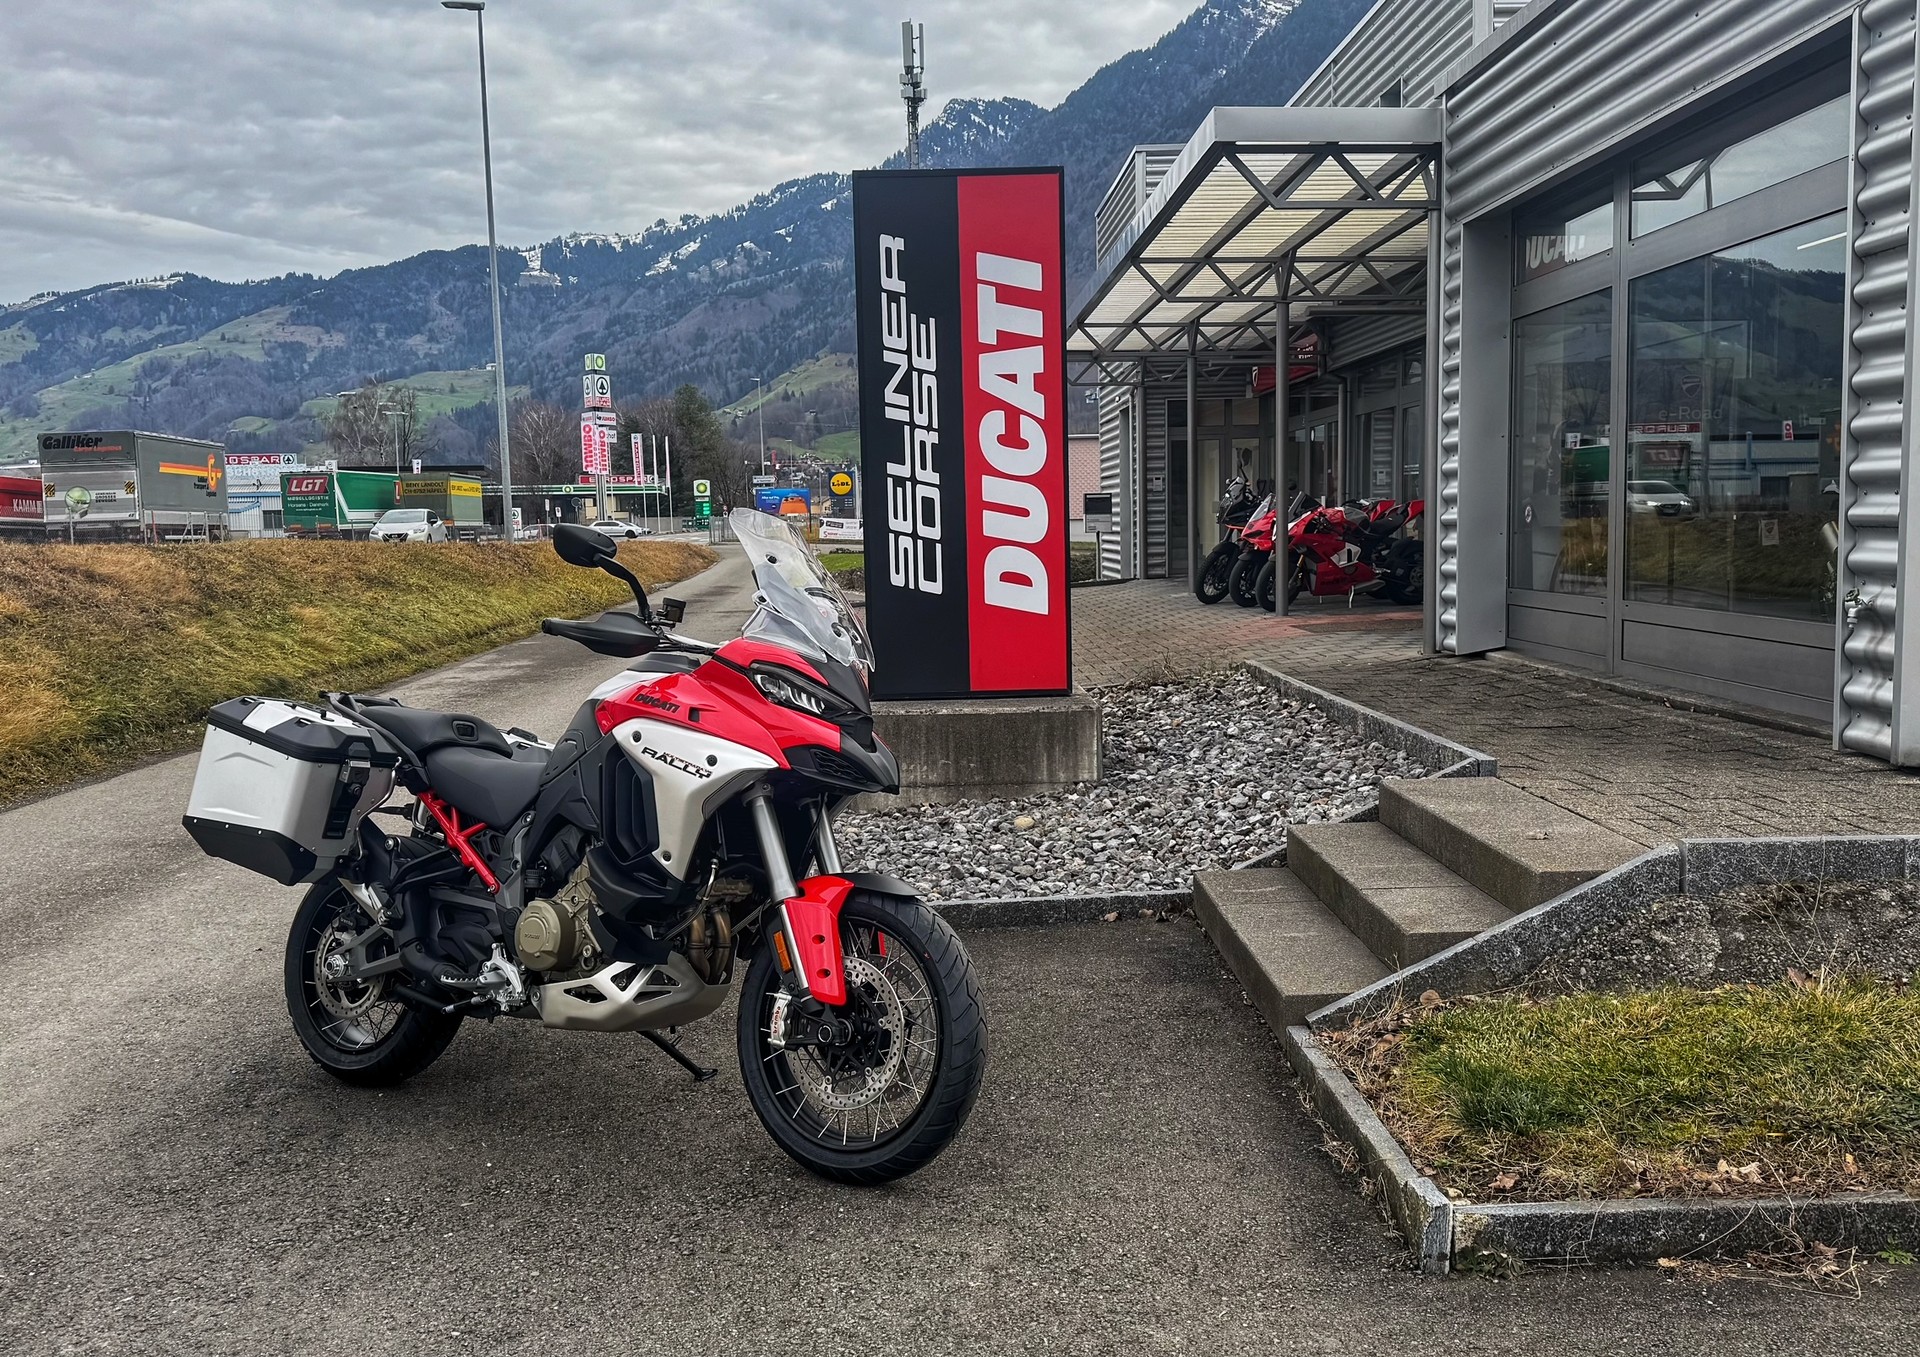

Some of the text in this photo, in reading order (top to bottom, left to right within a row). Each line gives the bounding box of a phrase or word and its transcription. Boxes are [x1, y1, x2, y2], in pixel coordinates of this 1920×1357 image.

[880, 233, 915, 590] SELINER
[42, 434, 103, 450] Galliker
[583, 424, 594, 471] JUMBO
[976, 251, 1050, 616] DUCATI
[910, 313, 943, 595] CORSE
[291, 479, 324, 491] LGT
[634, 694, 680, 713] DUCATI
[641, 746, 713, 779] RALLY
